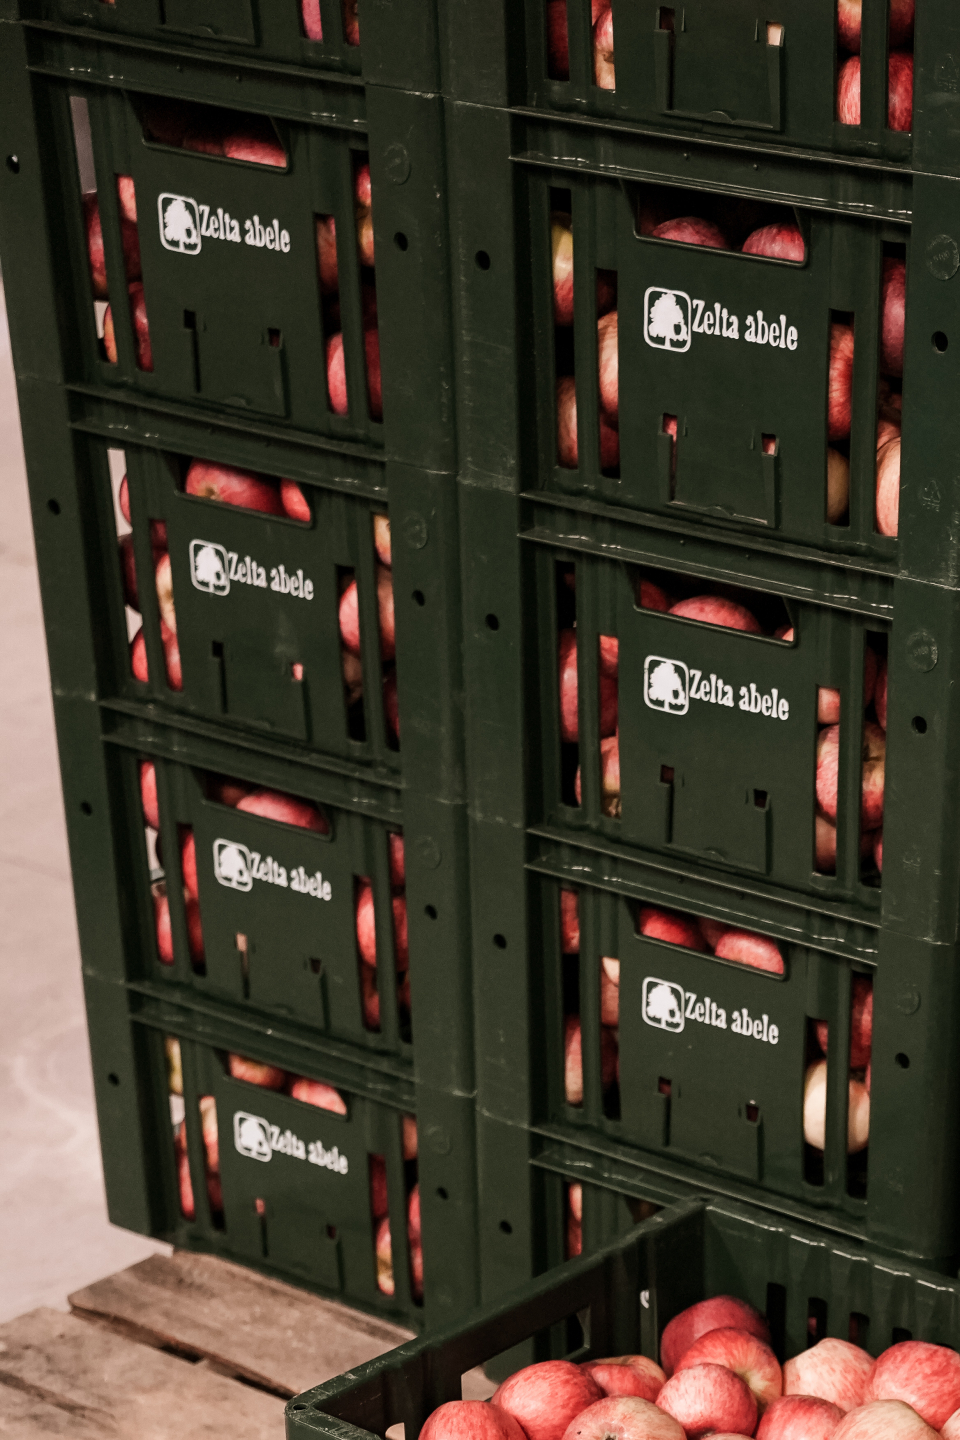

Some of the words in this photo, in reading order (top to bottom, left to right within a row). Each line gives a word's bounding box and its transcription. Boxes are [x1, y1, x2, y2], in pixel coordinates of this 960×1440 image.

[199, 204, 242, 243] Zelta
[692, 299, 740, 341] Zelta
[228, 551, 268, 589] Zelta
[689, 669, 735, 709] Zelta
[251, 852, 288, 888] Zelta
[685, 991, 728, 1030] Zelta
[270, 1125, 306, 1160] Zelta
